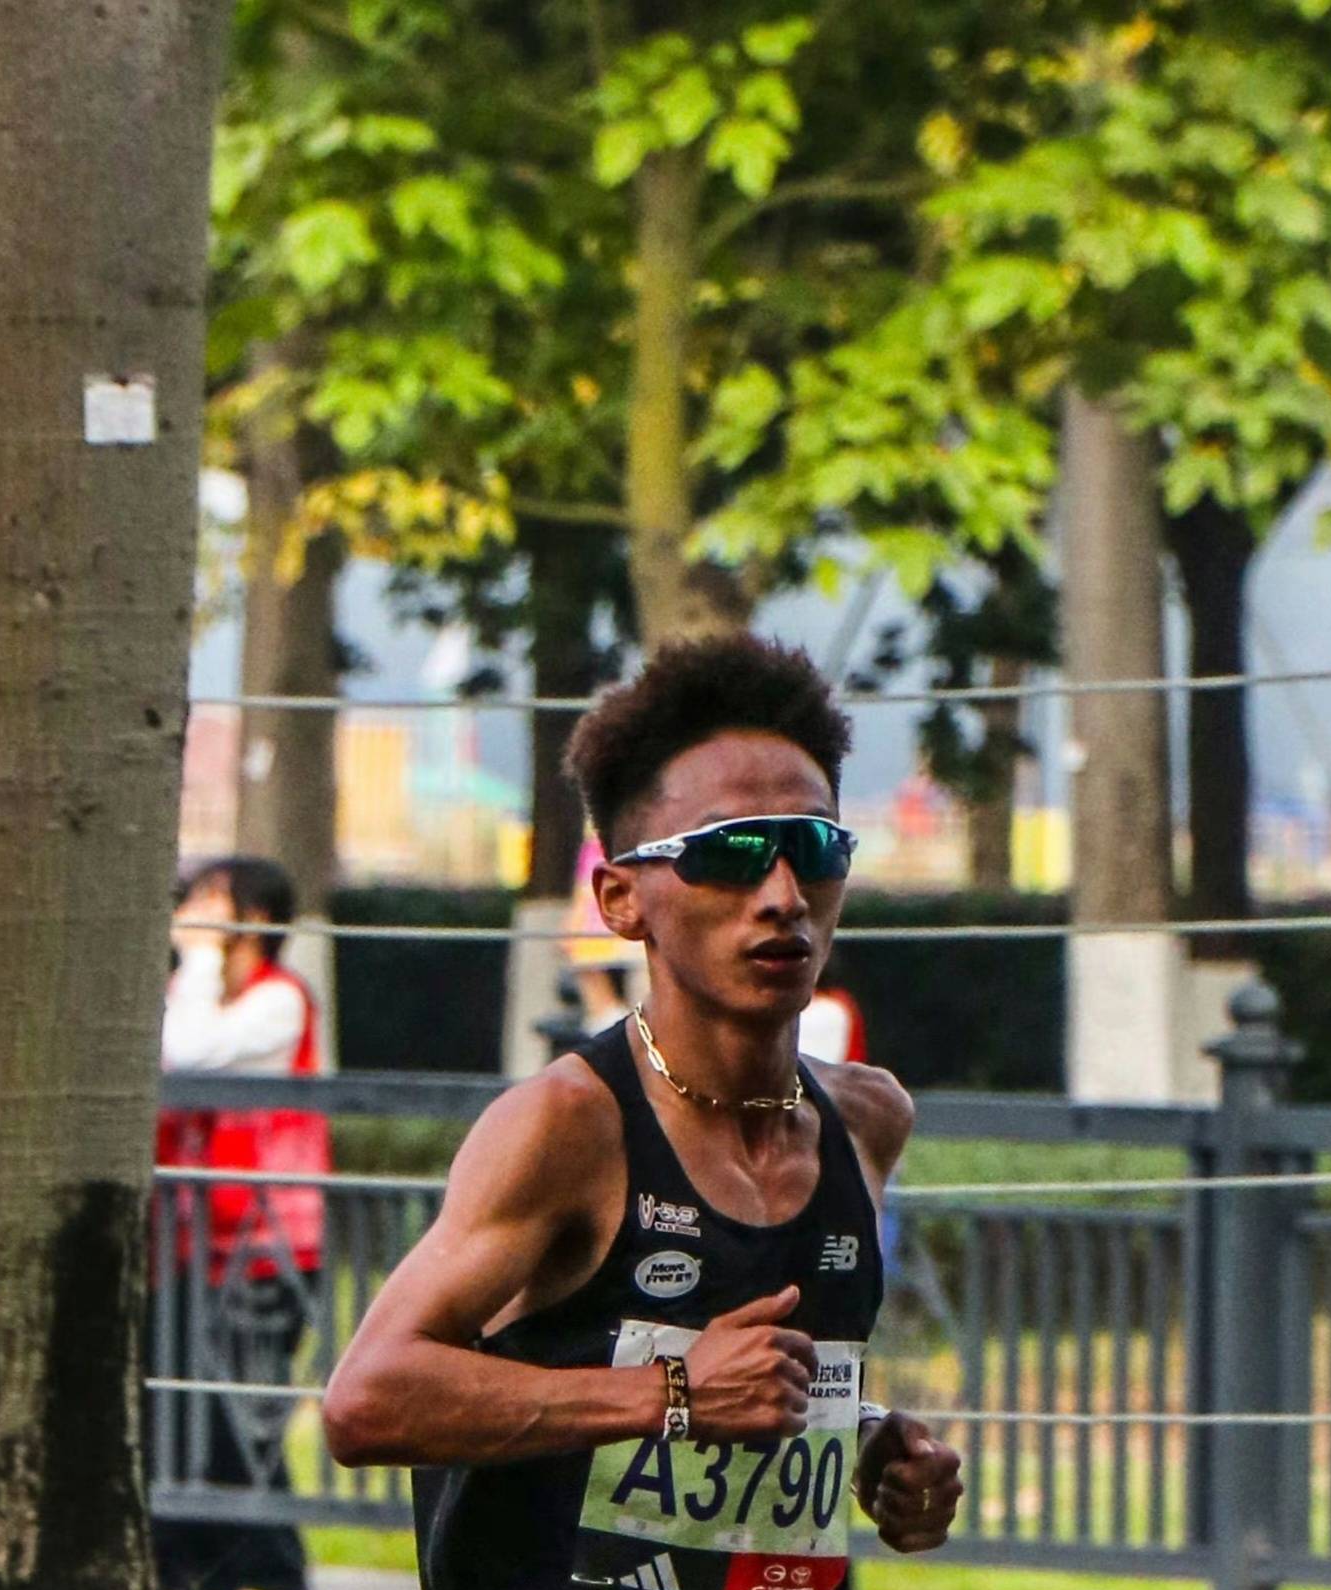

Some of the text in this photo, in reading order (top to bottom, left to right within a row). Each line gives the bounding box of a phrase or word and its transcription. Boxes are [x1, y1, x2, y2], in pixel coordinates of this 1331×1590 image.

[811, 1364, 852, 1383] 拉松赛
[806, 1387, 852, 1399] ARATHON
[609, 1435, 843, 1530] A3790
